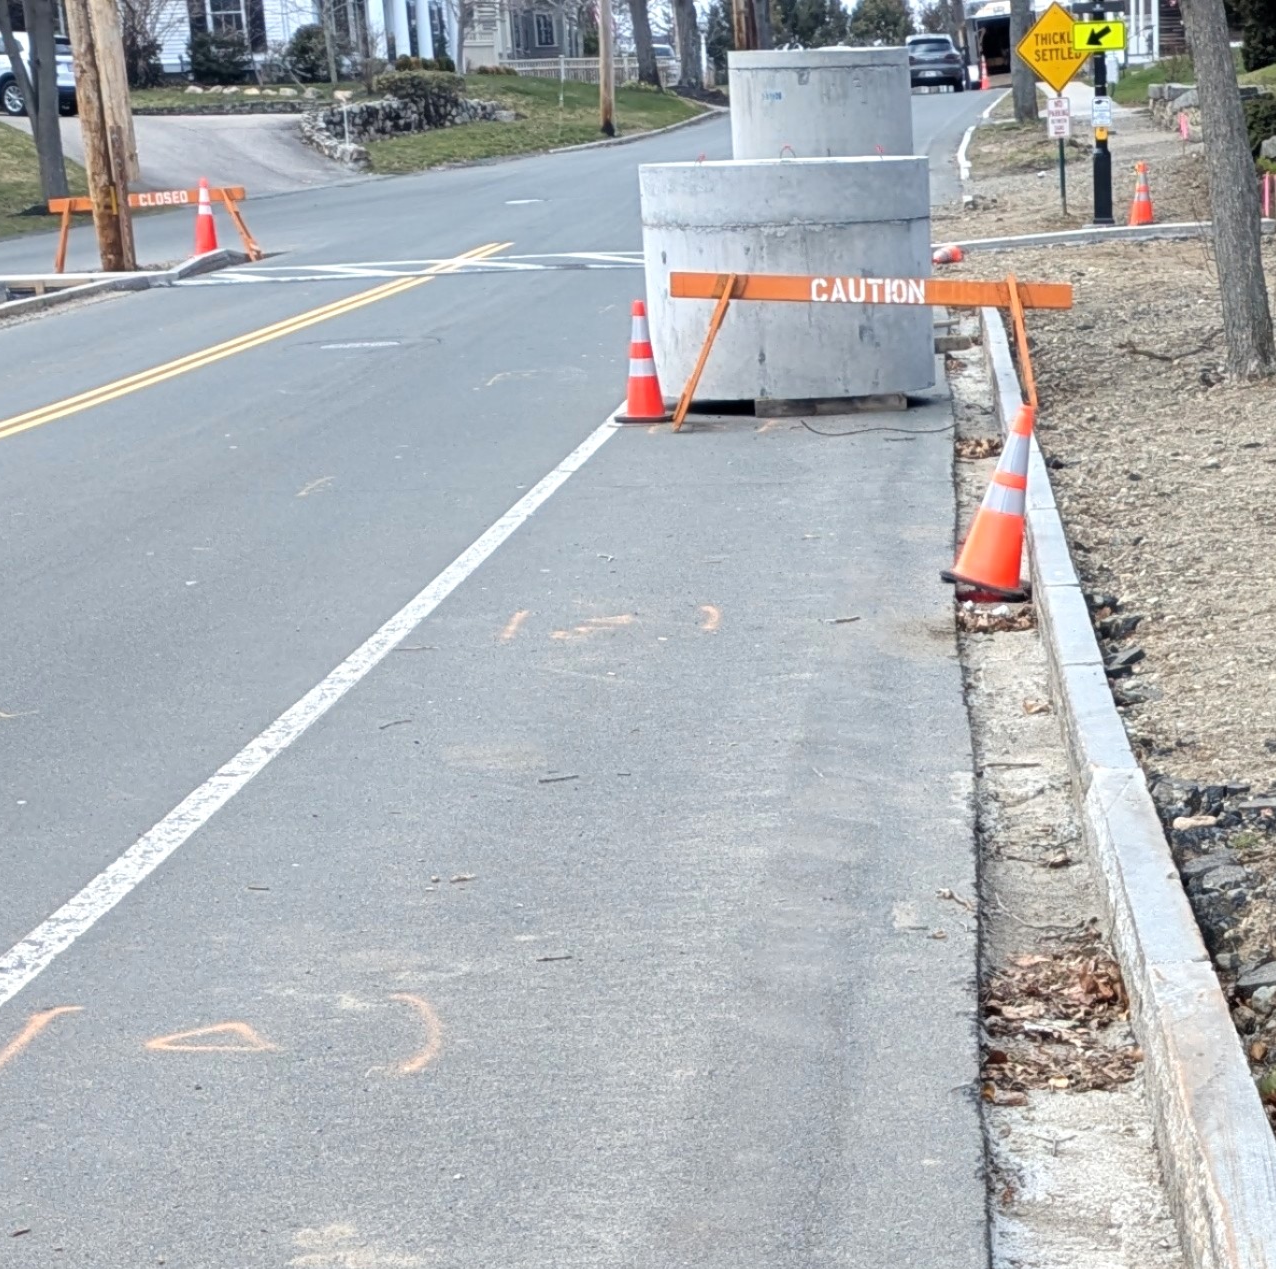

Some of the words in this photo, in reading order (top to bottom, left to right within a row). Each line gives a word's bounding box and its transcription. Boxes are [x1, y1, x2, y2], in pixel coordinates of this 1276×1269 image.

[1034, 32, 1073, 46] THICKL
[138, 190, 188, 206] CLOSED
[810, 277, 926, 304] CAUTION
